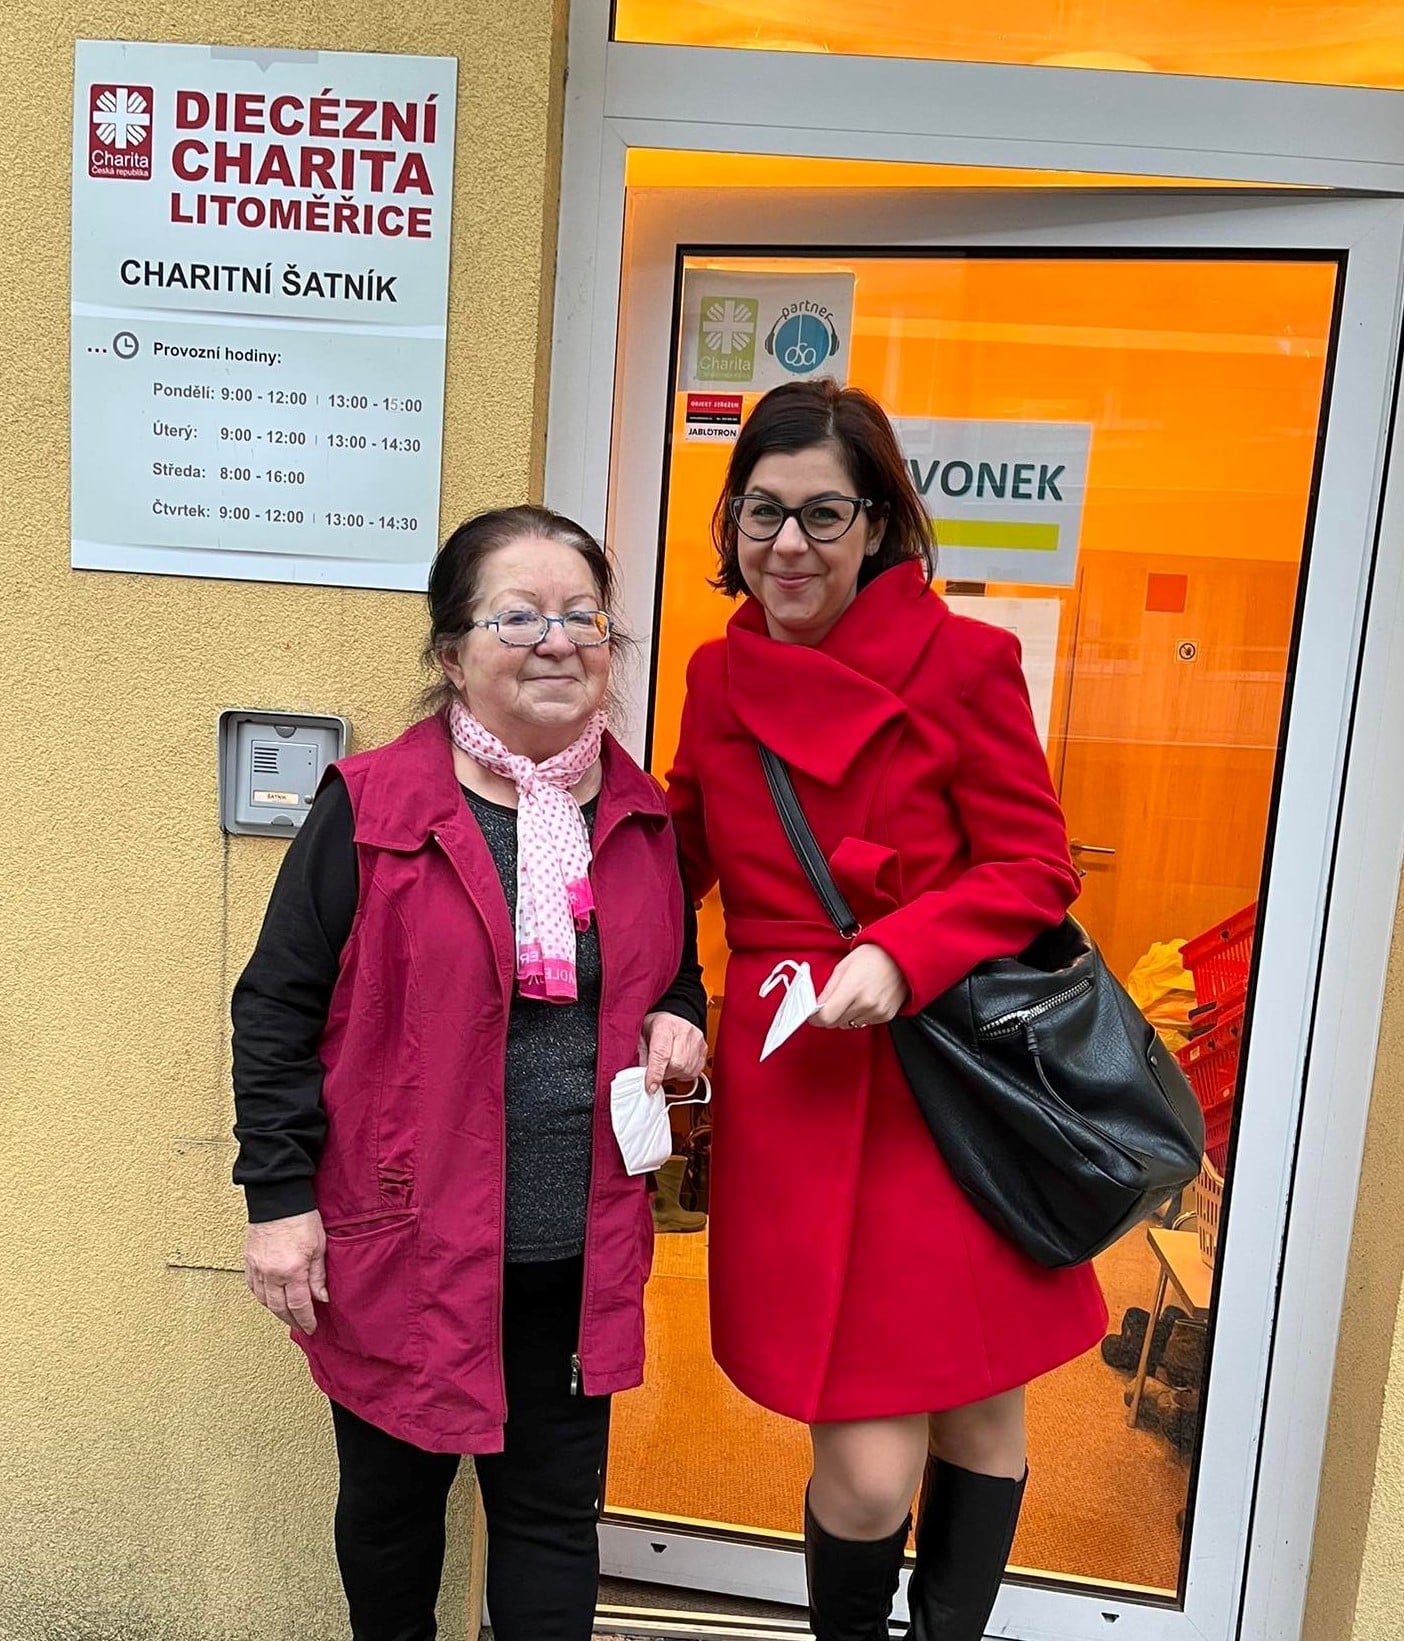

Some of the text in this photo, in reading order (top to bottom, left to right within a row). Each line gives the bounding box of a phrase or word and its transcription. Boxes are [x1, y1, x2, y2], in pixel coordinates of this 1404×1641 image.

[173, 87, 440, 144] DIECÉZNÍ
[91, 150, 149, 168] Charita
[91, 164, 149, 177] Česká republika
[171, 138, 435, 196] CHARITA
[170, 192, 433, 239] LITOMĚŘICE
[120, 259, 399, 303] CHARITNÍ ŠATNÍK
[781, 299, 834, 320] partner
[153, 341, 283, 367] Provozní hodiny:
[700, 355, 751, 372] Charita
[153, 382, 215, 401] Pondělí:
[221, 387, 253, 403] 9:00
[267, 389, 307, 406] 12:00
[328, 394, 369, 410] 13:00
[384, 397, 423, 413] 15:00
[153, 420, 198, 441] Úterý:
[220, 426, 252, 442] 9:00
[266, 429, 306, 446] 12:00
[327, 433, 367, 449] 13:00
[381, 437, 421, 453] 14:30
[688, 427, 738, 438] JABLOTRON
[152, 462, 206, 480] Středa:
[220, 466, 251, 482] 8:00
[265, 469, 305, 485] 16:00
[903, 458, 1066, 502] VONEK
[152, 499, 211, 518] Čtvrtek:
[219, 505, 251, 521] 9:00
[264, 508, 304, 524] 12:00
[325, 512, 364, 528] 13:00
[378, 516, 418, 532] 14:30
